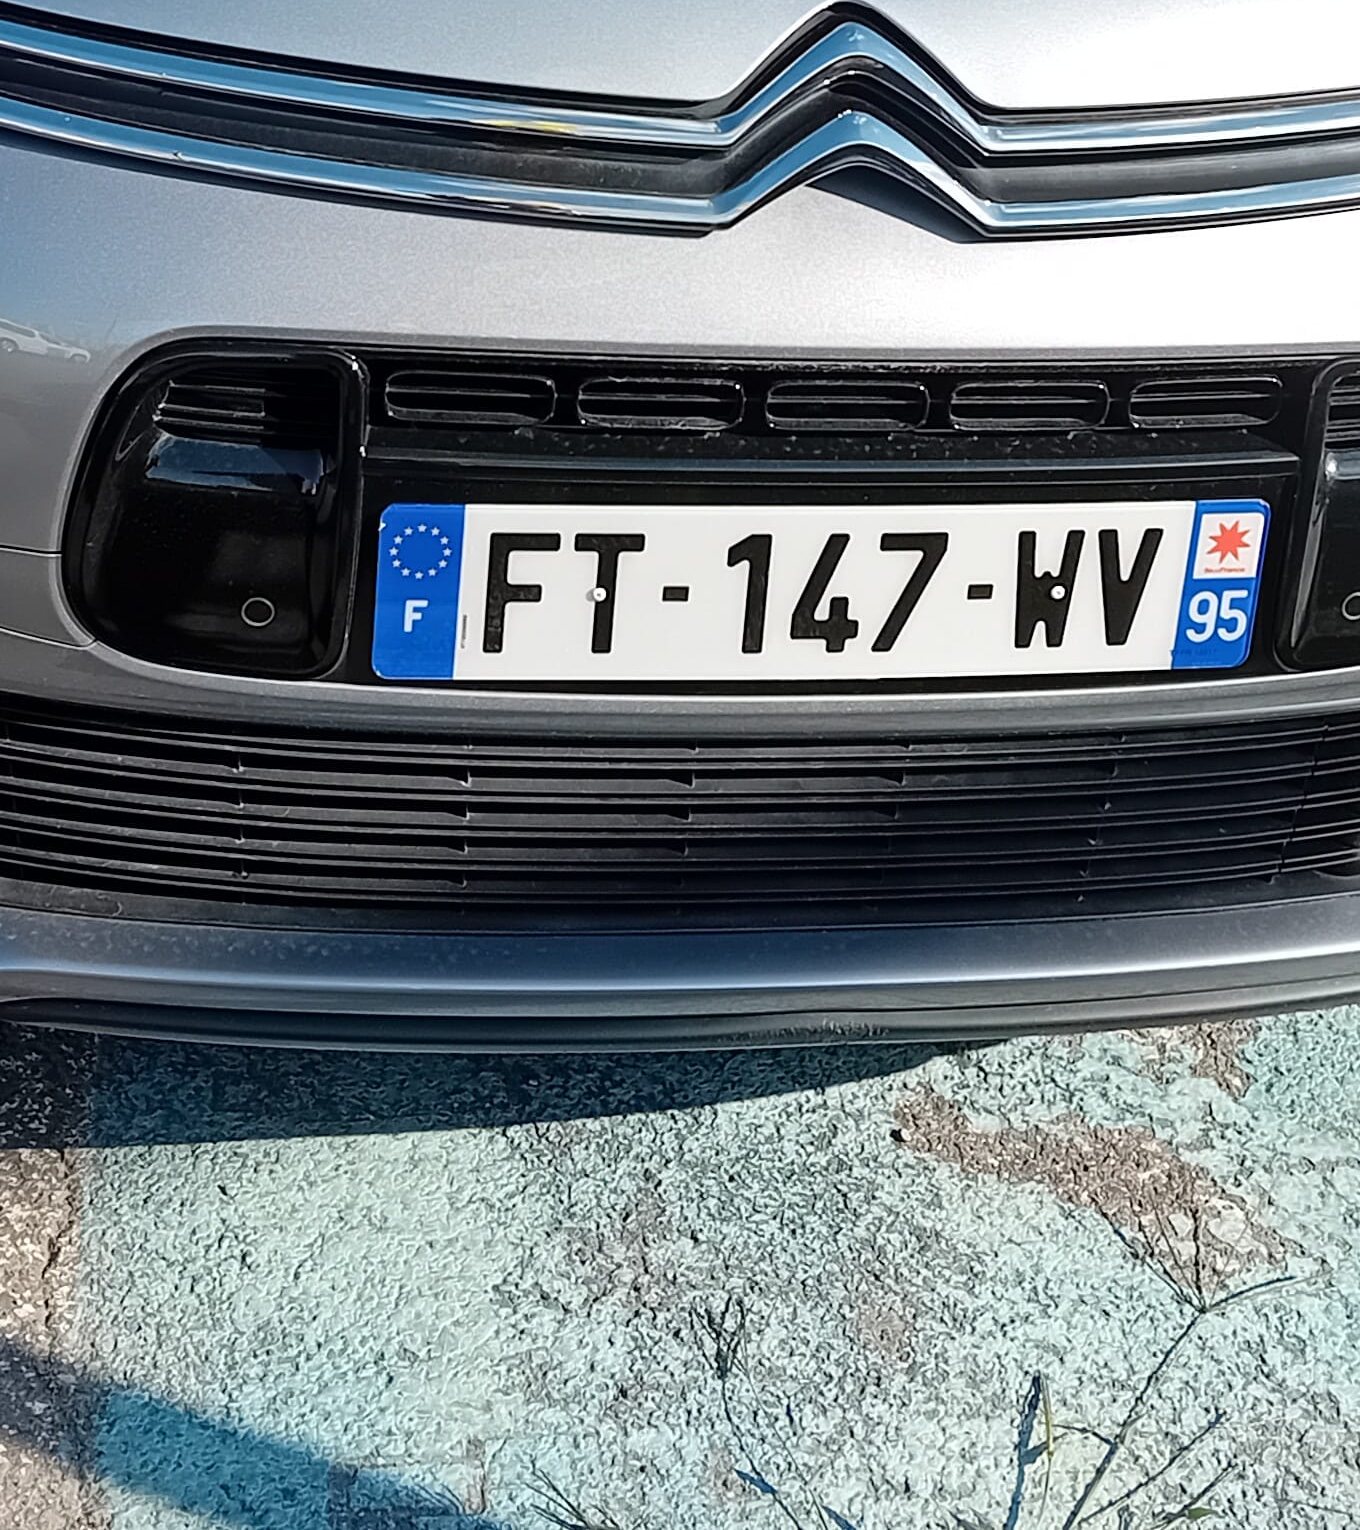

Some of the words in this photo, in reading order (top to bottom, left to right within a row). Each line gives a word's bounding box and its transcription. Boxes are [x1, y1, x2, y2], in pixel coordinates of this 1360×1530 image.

[403, 599, 428, 633] F
[482, 528, 1164, 653] FT-147-WV
[1185, 589, 1249, 643] 95
